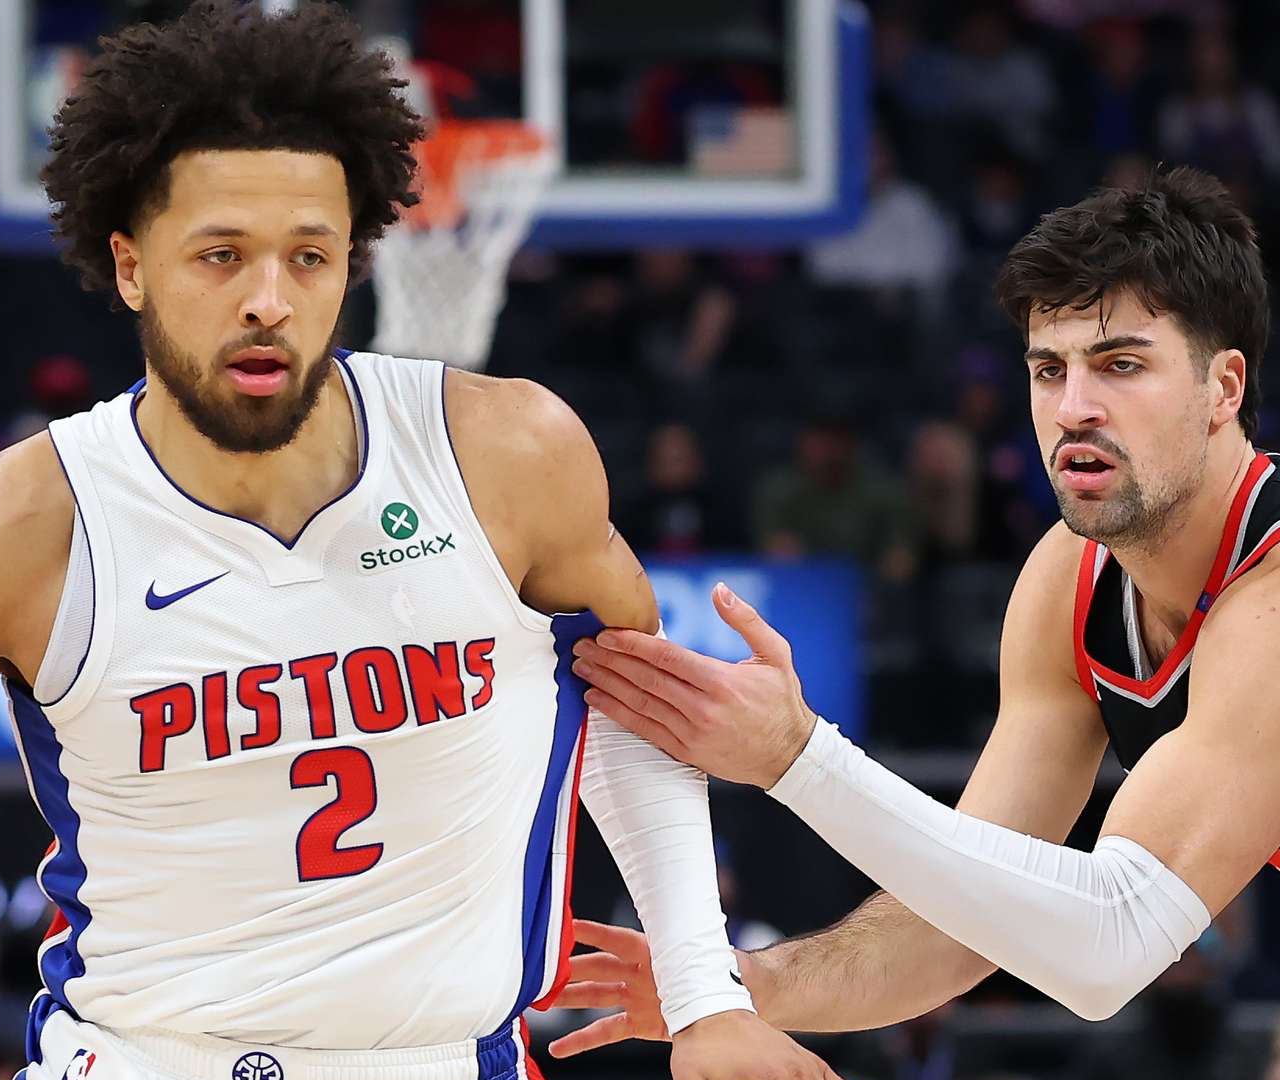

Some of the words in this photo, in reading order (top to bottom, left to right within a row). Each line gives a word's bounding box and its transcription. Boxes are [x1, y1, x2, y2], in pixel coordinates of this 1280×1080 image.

[359, 533, 456, 570] StockX
[129, 637, 496, 773] PISTONS
[289, 745, 384, 883] 2
